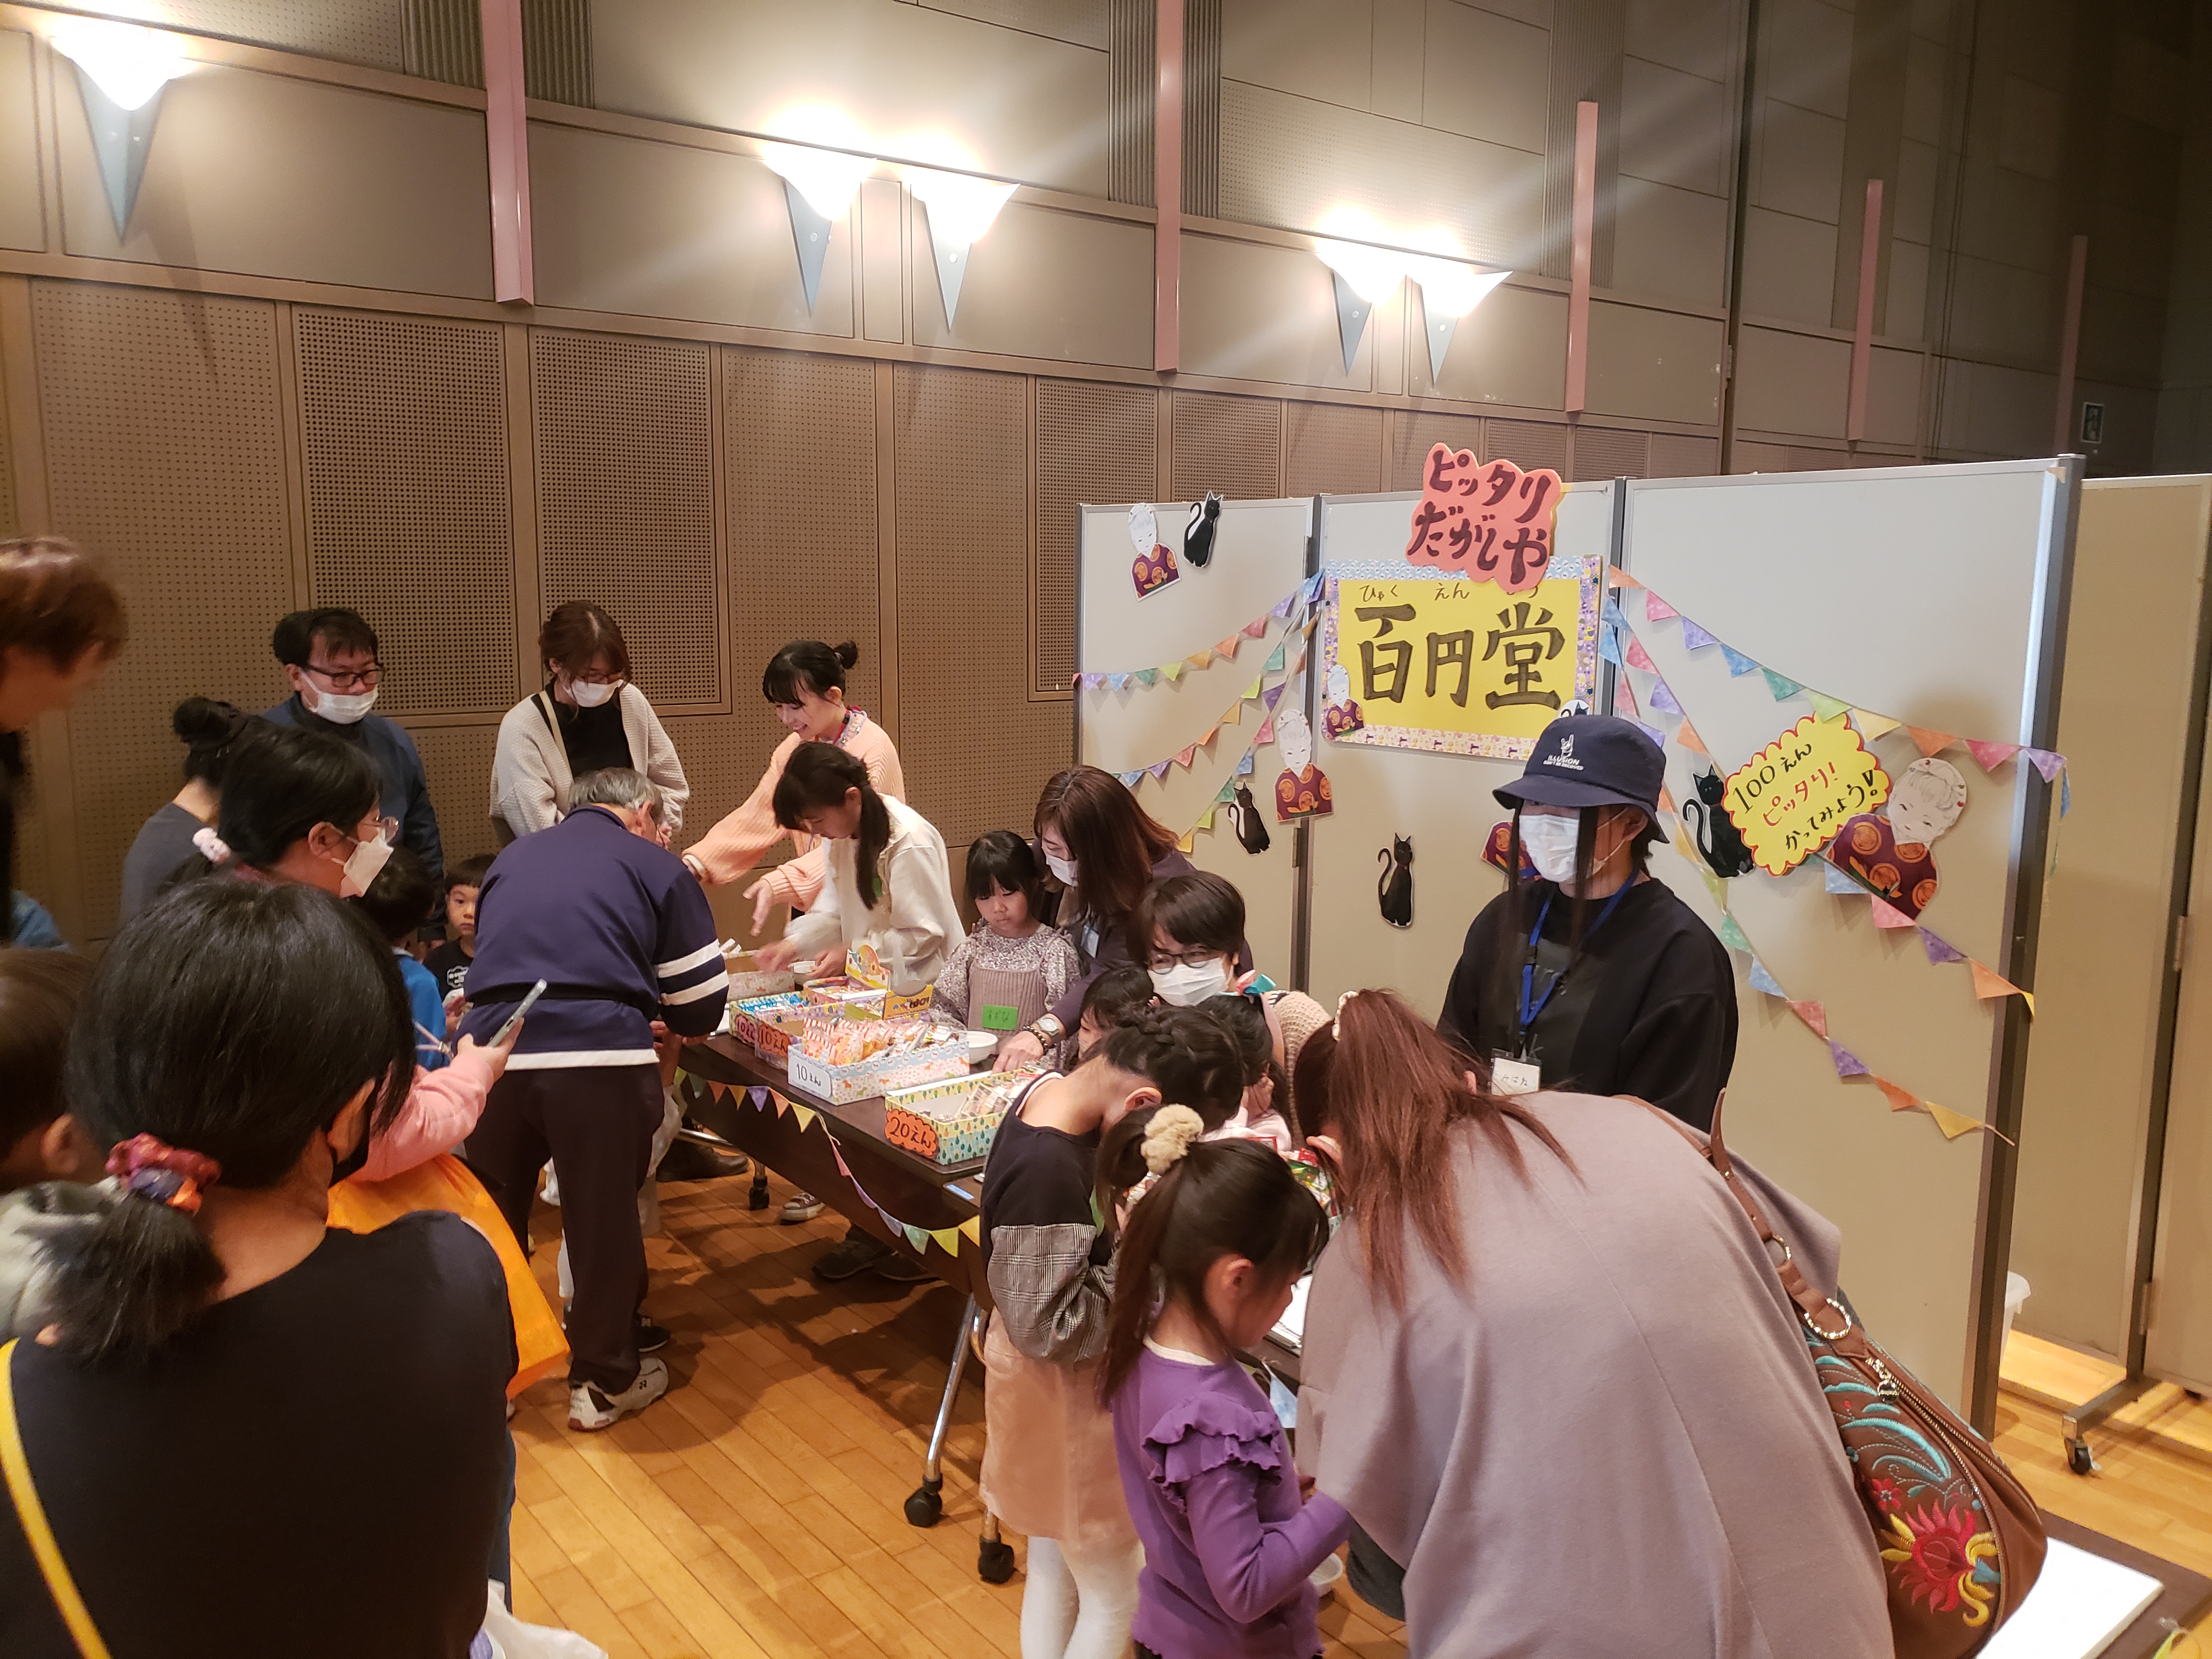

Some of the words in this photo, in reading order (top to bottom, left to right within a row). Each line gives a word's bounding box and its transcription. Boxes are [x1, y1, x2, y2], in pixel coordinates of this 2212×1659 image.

[1429, 450, 1551, 523] ピッタリ
[1407, 501, 1548, 585] だがしや
[1359, 584, 1399, 602] ひゃく
[1434, 582, 1470, 601] えん
[1354, 601, 1566, 711] 百円堂
[1732, 743, 1812, 814] 100えん
[797, 1063, 822, 1087] 10えん
[890, 1116, 932, 1149] 20えん
